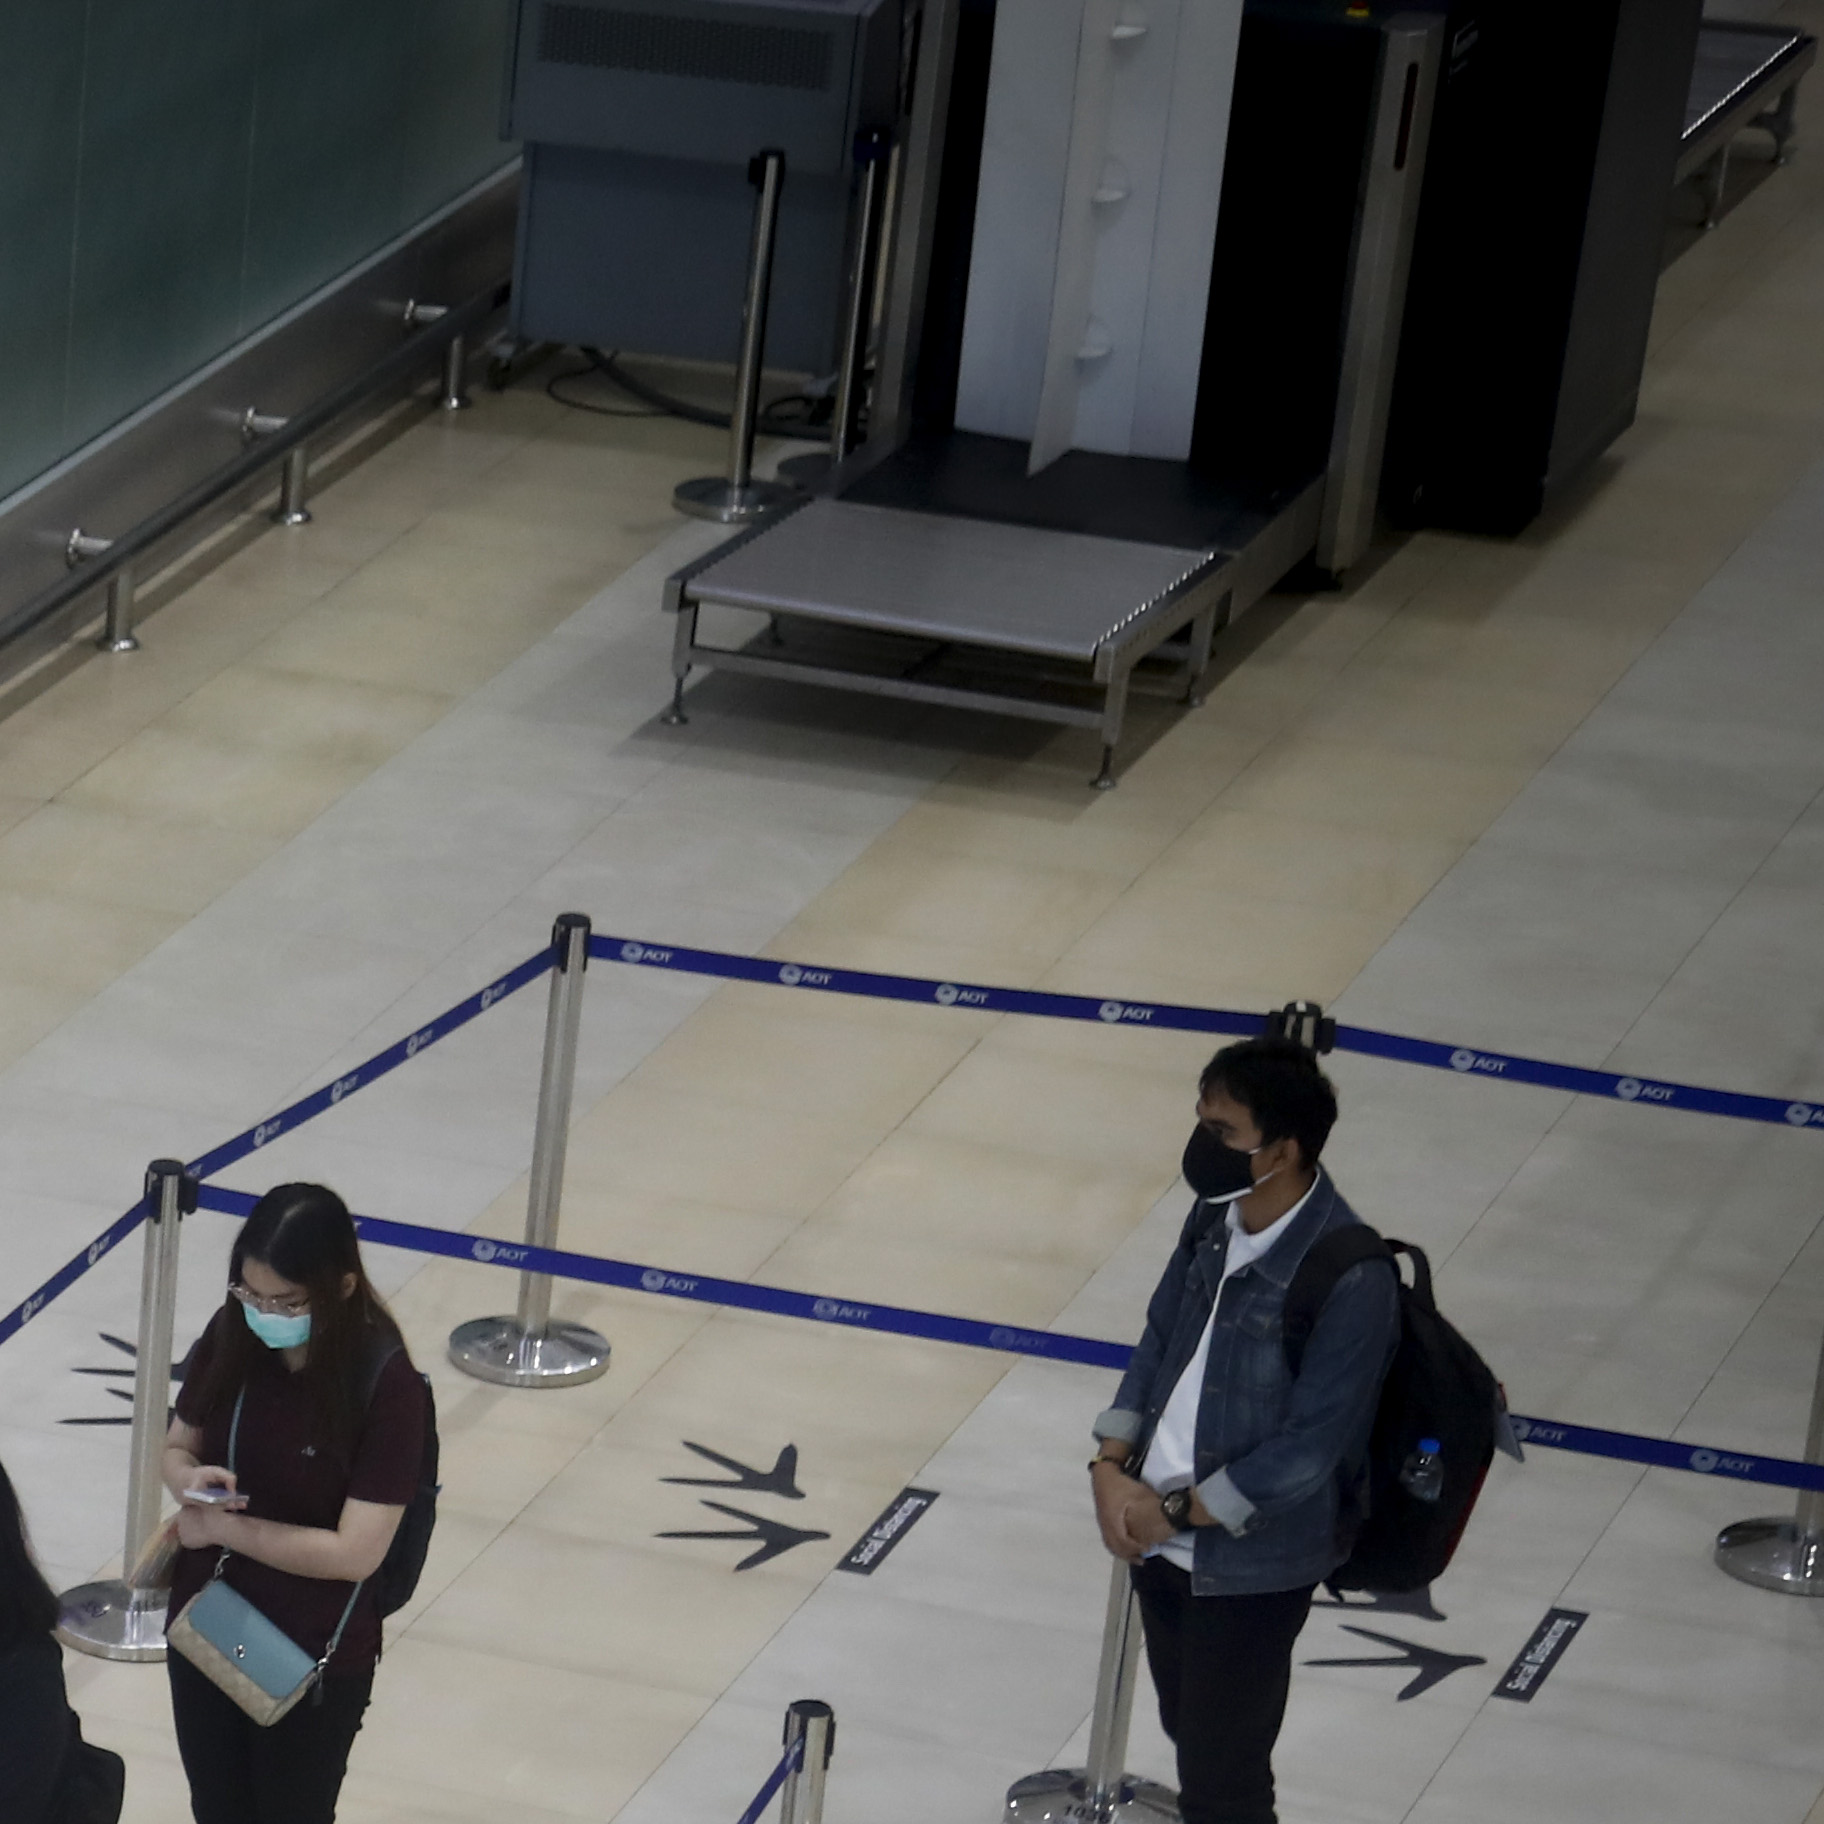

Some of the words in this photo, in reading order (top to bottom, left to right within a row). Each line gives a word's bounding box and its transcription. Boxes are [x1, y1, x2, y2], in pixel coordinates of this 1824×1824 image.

[643, 949, 672, 963] AOT
[802, 970, 832, 986] AOT
[958, 990, 989, 1004] AOT
[1122, 1005, 1154, 1020] AOT
[1473, 1056, 1507, 1073] AOT
[1640, 1085, 1675, 1101] AOT
[496, 1248, 528, 1262] AOT
[665, 1277, 698, 1294] AOT
[838, 1305, 871, 1321] AOT
[1530, 1426, 1566, 1441] AOT
[1717, 1458, 1754, 1473] AOT
